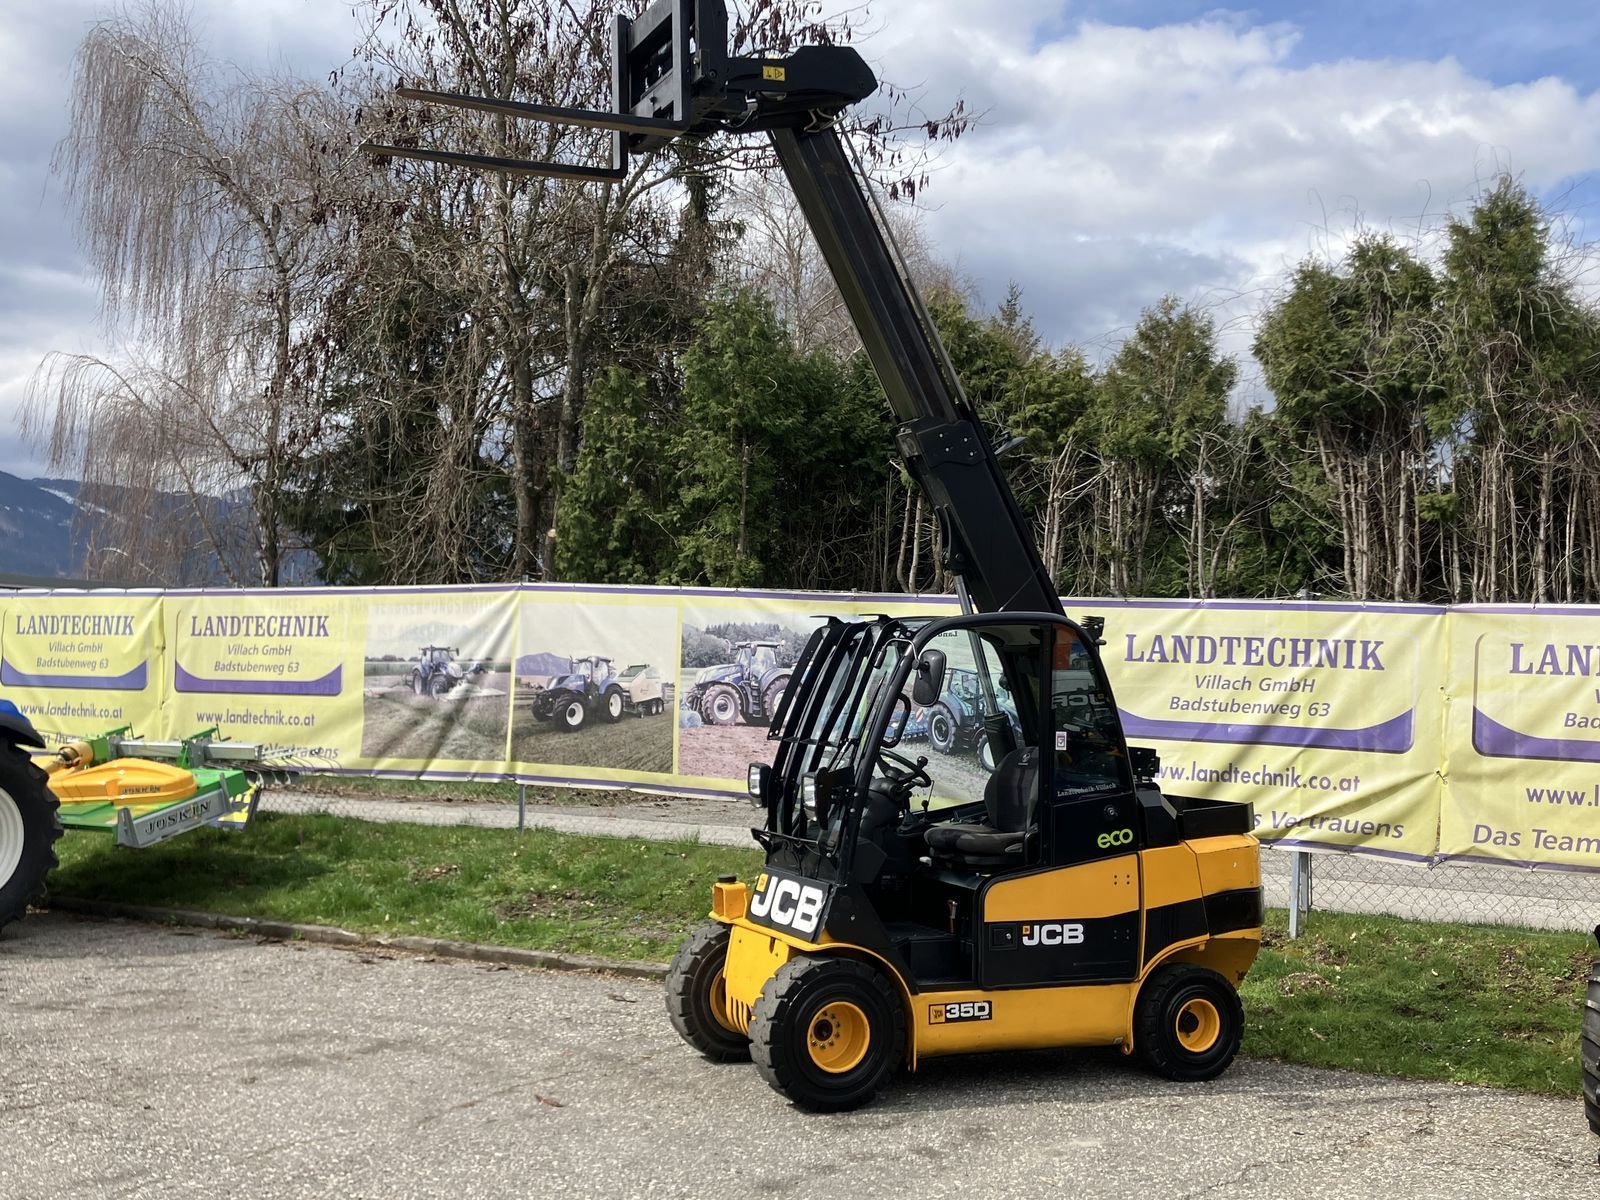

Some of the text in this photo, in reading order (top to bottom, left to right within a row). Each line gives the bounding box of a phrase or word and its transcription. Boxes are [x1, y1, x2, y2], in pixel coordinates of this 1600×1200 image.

[16, 615, 135, 636] LANDTECHNIK
[190, 616, 329, 637] LANDTECHNIK
[49, 642, 103, 653] Villach GmbH
[227, 645, 292, 656] Villach GmbH
[1124, 634, 1385, 670] LANDTECHNIK
[36, 658, 109, 671] Badstubenweg 63
[214, 661, 300, 675] Badstubenweg 63
[1509, 643, 1600, 676] LAN
[1195, 675, 1316, 693] Villach GmbH
[20, 701, 122, 719] www.landtechnik.co.at
[1169, 696, 1331, 718] Badstubenweg 63
[196, 709, 315, 727] www.landtechnik.co.at
[1158, 761, 1360, 792] ww.landtechnik.co.at
[1271, 811, 1404, 839] Vertrauens
[1097, 829, 1133, 849] eco
[1473, 824, 1600, 853] Das Team
[750, 875, 824, 933] JCB
[1022, 924, 1085, 946] JCB
[945, 1002, 990, 1019] 35D
